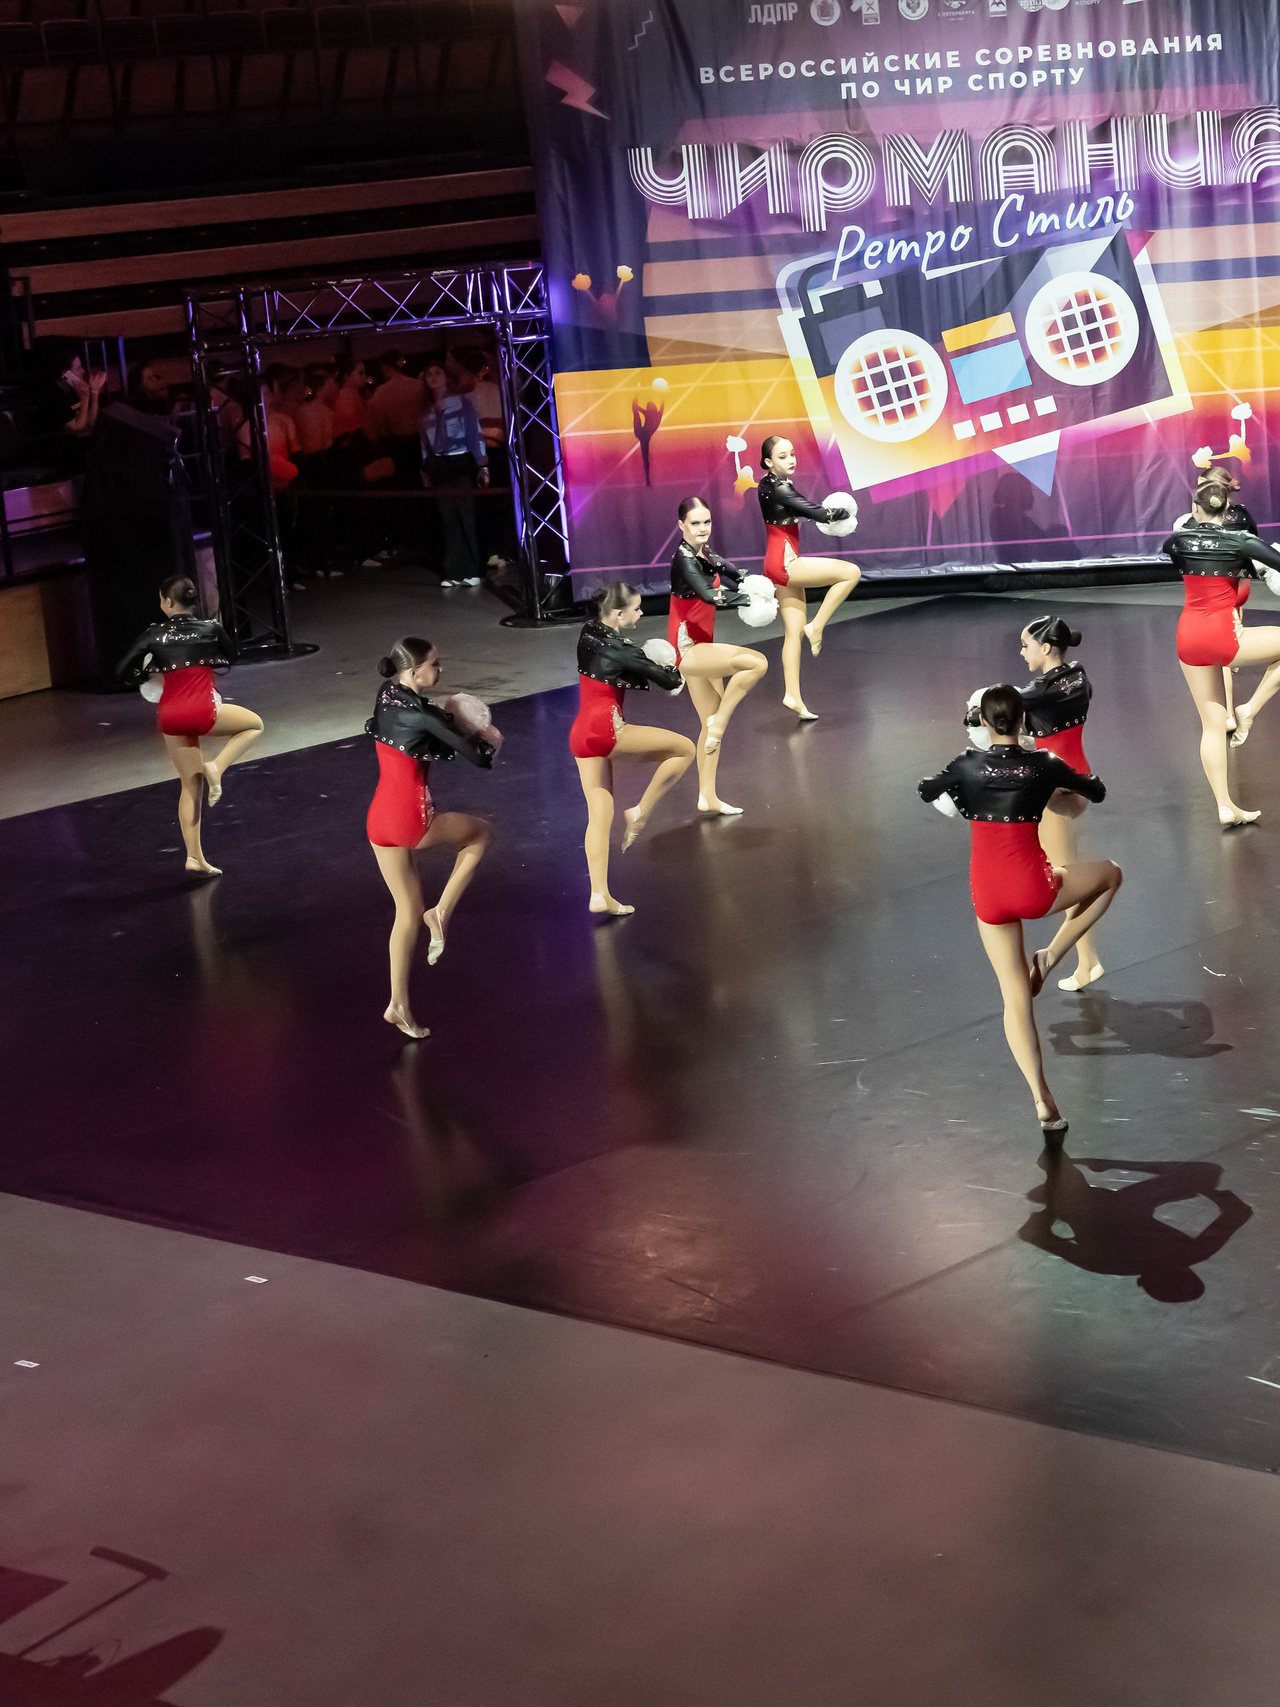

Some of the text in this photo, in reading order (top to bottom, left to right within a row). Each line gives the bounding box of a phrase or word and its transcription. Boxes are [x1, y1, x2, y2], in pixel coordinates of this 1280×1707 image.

[749, 2, 799, 26] ЛДПР
[699, 33, 1223, 84] ВСЕРОССИЙСКИЕ СОРЕВНОВАНИЯ
[840, 67, 1086, 100] ПО ЧИР СПОРТУ
[831, 192, 1136, 281] Ретро Стиль
